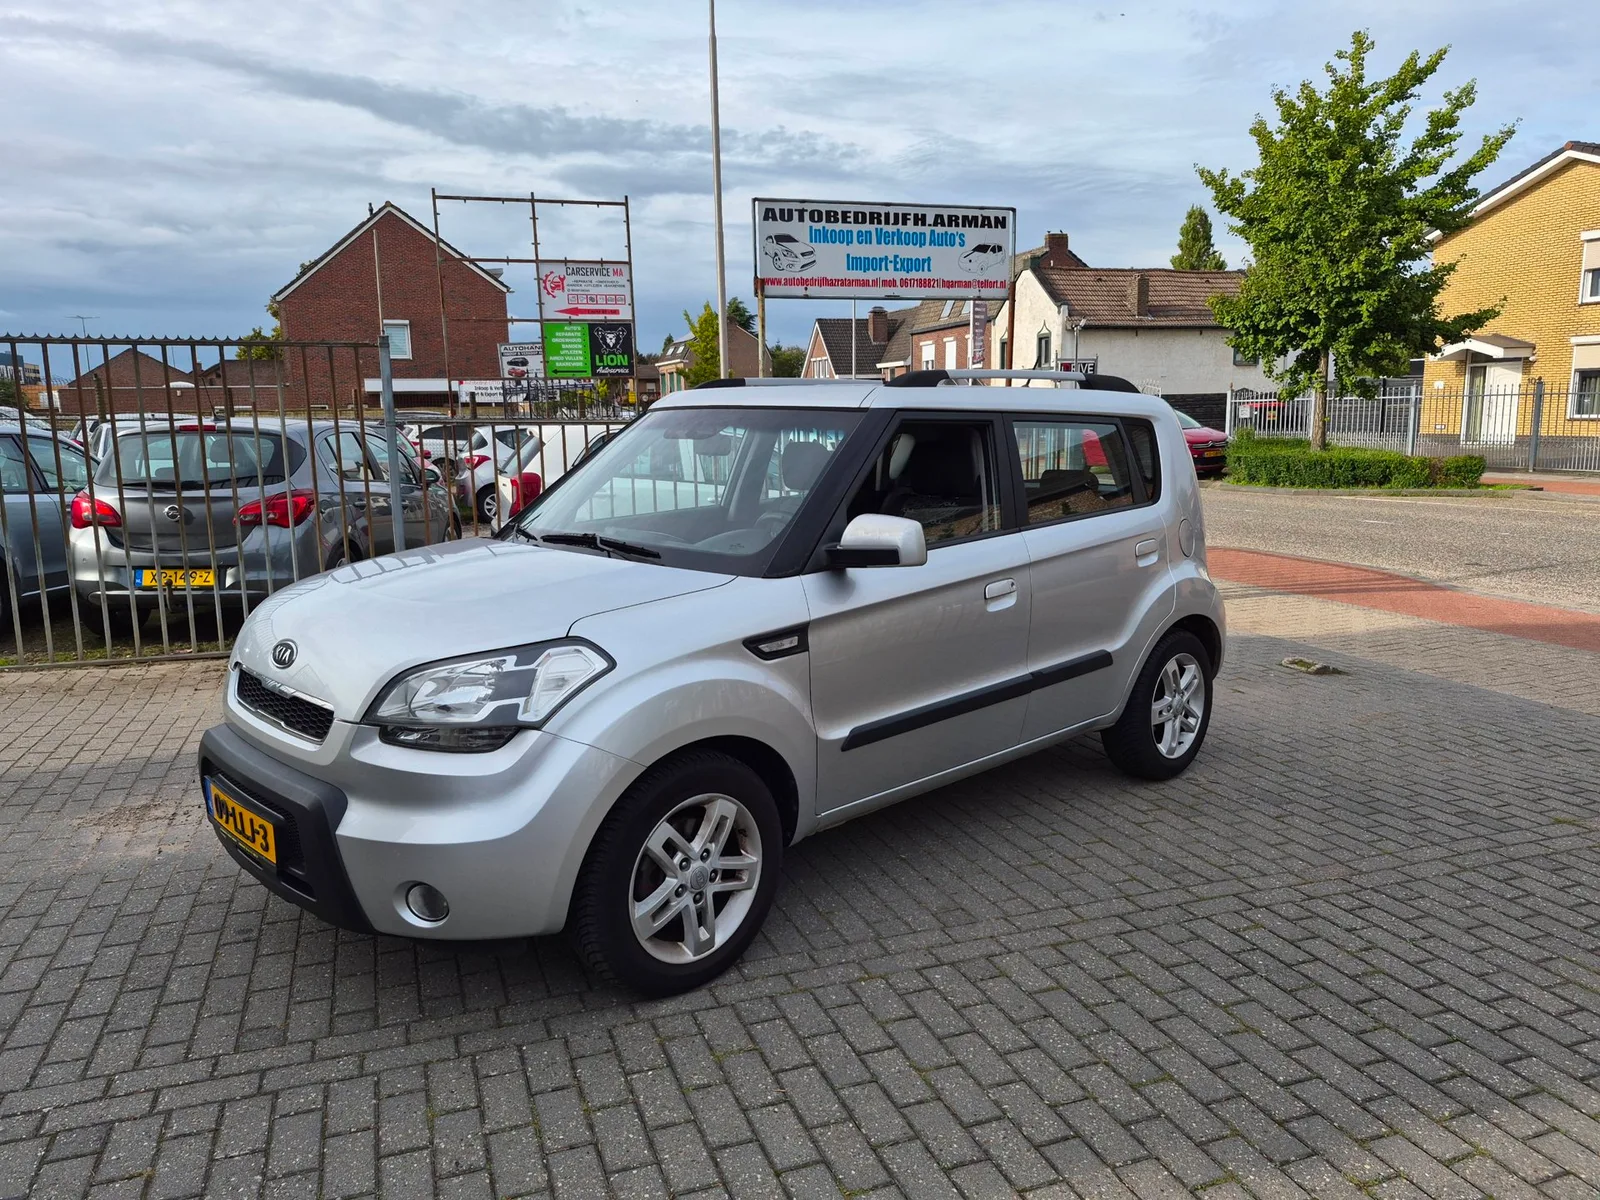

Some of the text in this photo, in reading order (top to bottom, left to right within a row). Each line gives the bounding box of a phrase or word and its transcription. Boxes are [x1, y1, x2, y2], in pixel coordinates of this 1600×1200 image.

[808, 226, 966, 248] Inkoop en Verkoop Auto's
[846, 253, 932, 274] Import-Export
[565, 266, 624, 277] CARSERVICE MA
[595, 354, 629, 366] LION
[596, 366, 629, 374] Autoservice
[275, 645, 291, 664] KIA
